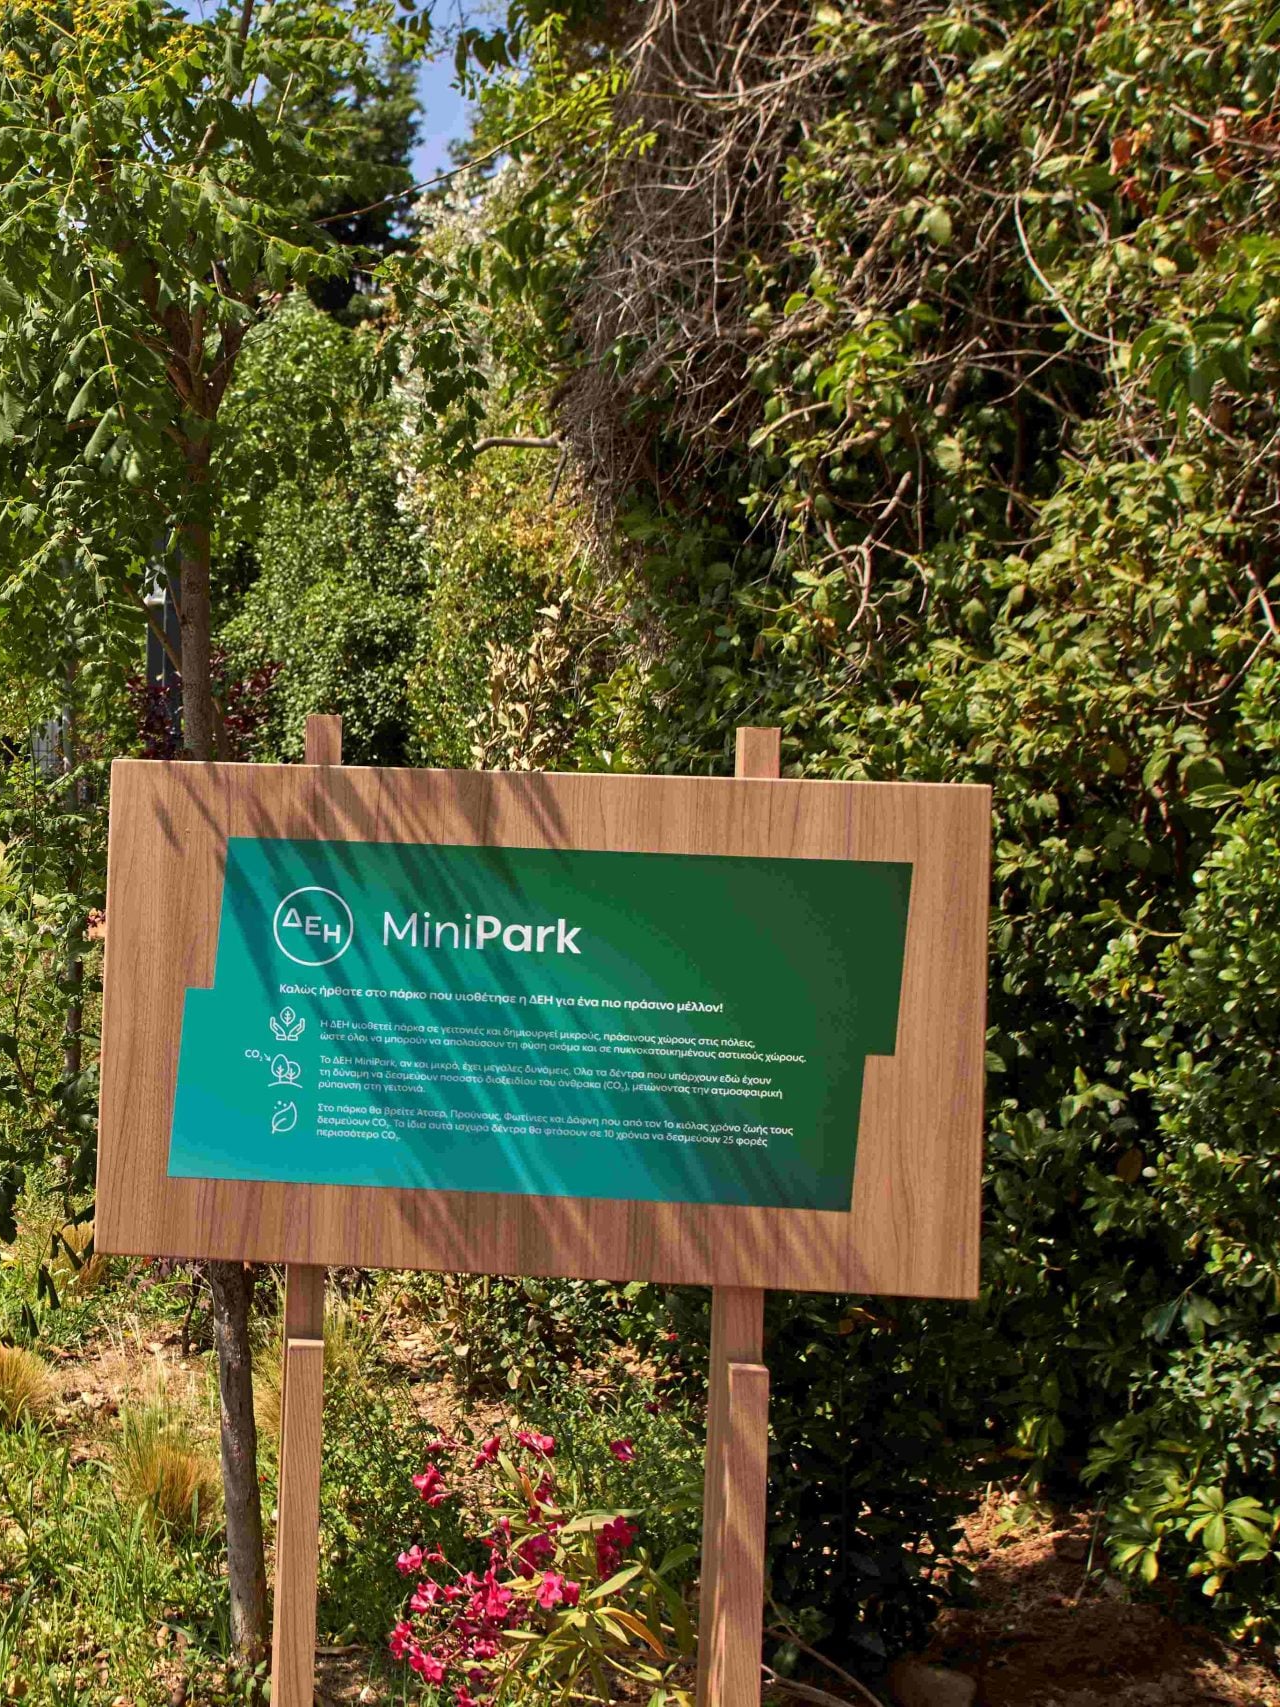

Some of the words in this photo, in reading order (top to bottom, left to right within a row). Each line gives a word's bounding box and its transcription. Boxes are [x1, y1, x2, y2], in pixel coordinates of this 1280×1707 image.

[282, 908, 341, 944] ΔΕΗ
[383, 911, 582, 954] MiniPark
[279, 983, 316, 997] Καλώς
[319, 984, 362, 998] ήρθατε
[365, 989, 387, 998] στο
[389, 987, 426, 1002] πάρκο
[429, 992, 452, 1001] που
[455, 991, 516, 1005] υιοθέτησε
[529, 994, 553, 1005] ΔΕΗ
[555, 997, 574, 1008] για
[577, 995, 599, 1007] ένα
[601, 999, 621, 1008] πιο
[623, 997, 674, 1011] πράσινο
[676, 999, 723, 1013] μέλλον!
[657, 1034, 696, 1046] χώρους
[697, 1038, 719, 1048] στις
[613, 1047, 716, 1060] πυκνοκατοικημένους
[717, 1050, 763, 1062] αστικούς
[608, 1068, 645, 1080] δέντρα
[668, 1071, 718, 1083] υπάρχουν
[719, 1073, 740, 1083] εδώ
[742, 1073, 771, 1085] έχουν
[632, 1082, 690, 1095] μειώνοντας
[691, 1086, 709, 1096] την
[710, 1087, 782, 1099] ατμοσφαιρική
[622, 1118, 642, 1128] από
[644, 1121, 661, 1129] τον
[663, 1120, 674, 1129] 1ο
[675, 1121, 708, 1133] κιόλας
[710, 1122, 741, 1134] χρόνο
[742, 1124, 768, 1136] ζωής
[769, 1128, 793, 1137] τους
[615, 1129, 649, 1141] χρόνια
[665, 1131, 721, 1144] δεσμεύουν
[722, 1135, 733, 1144] 25
[735, 1135, 767, 1147] φορές
